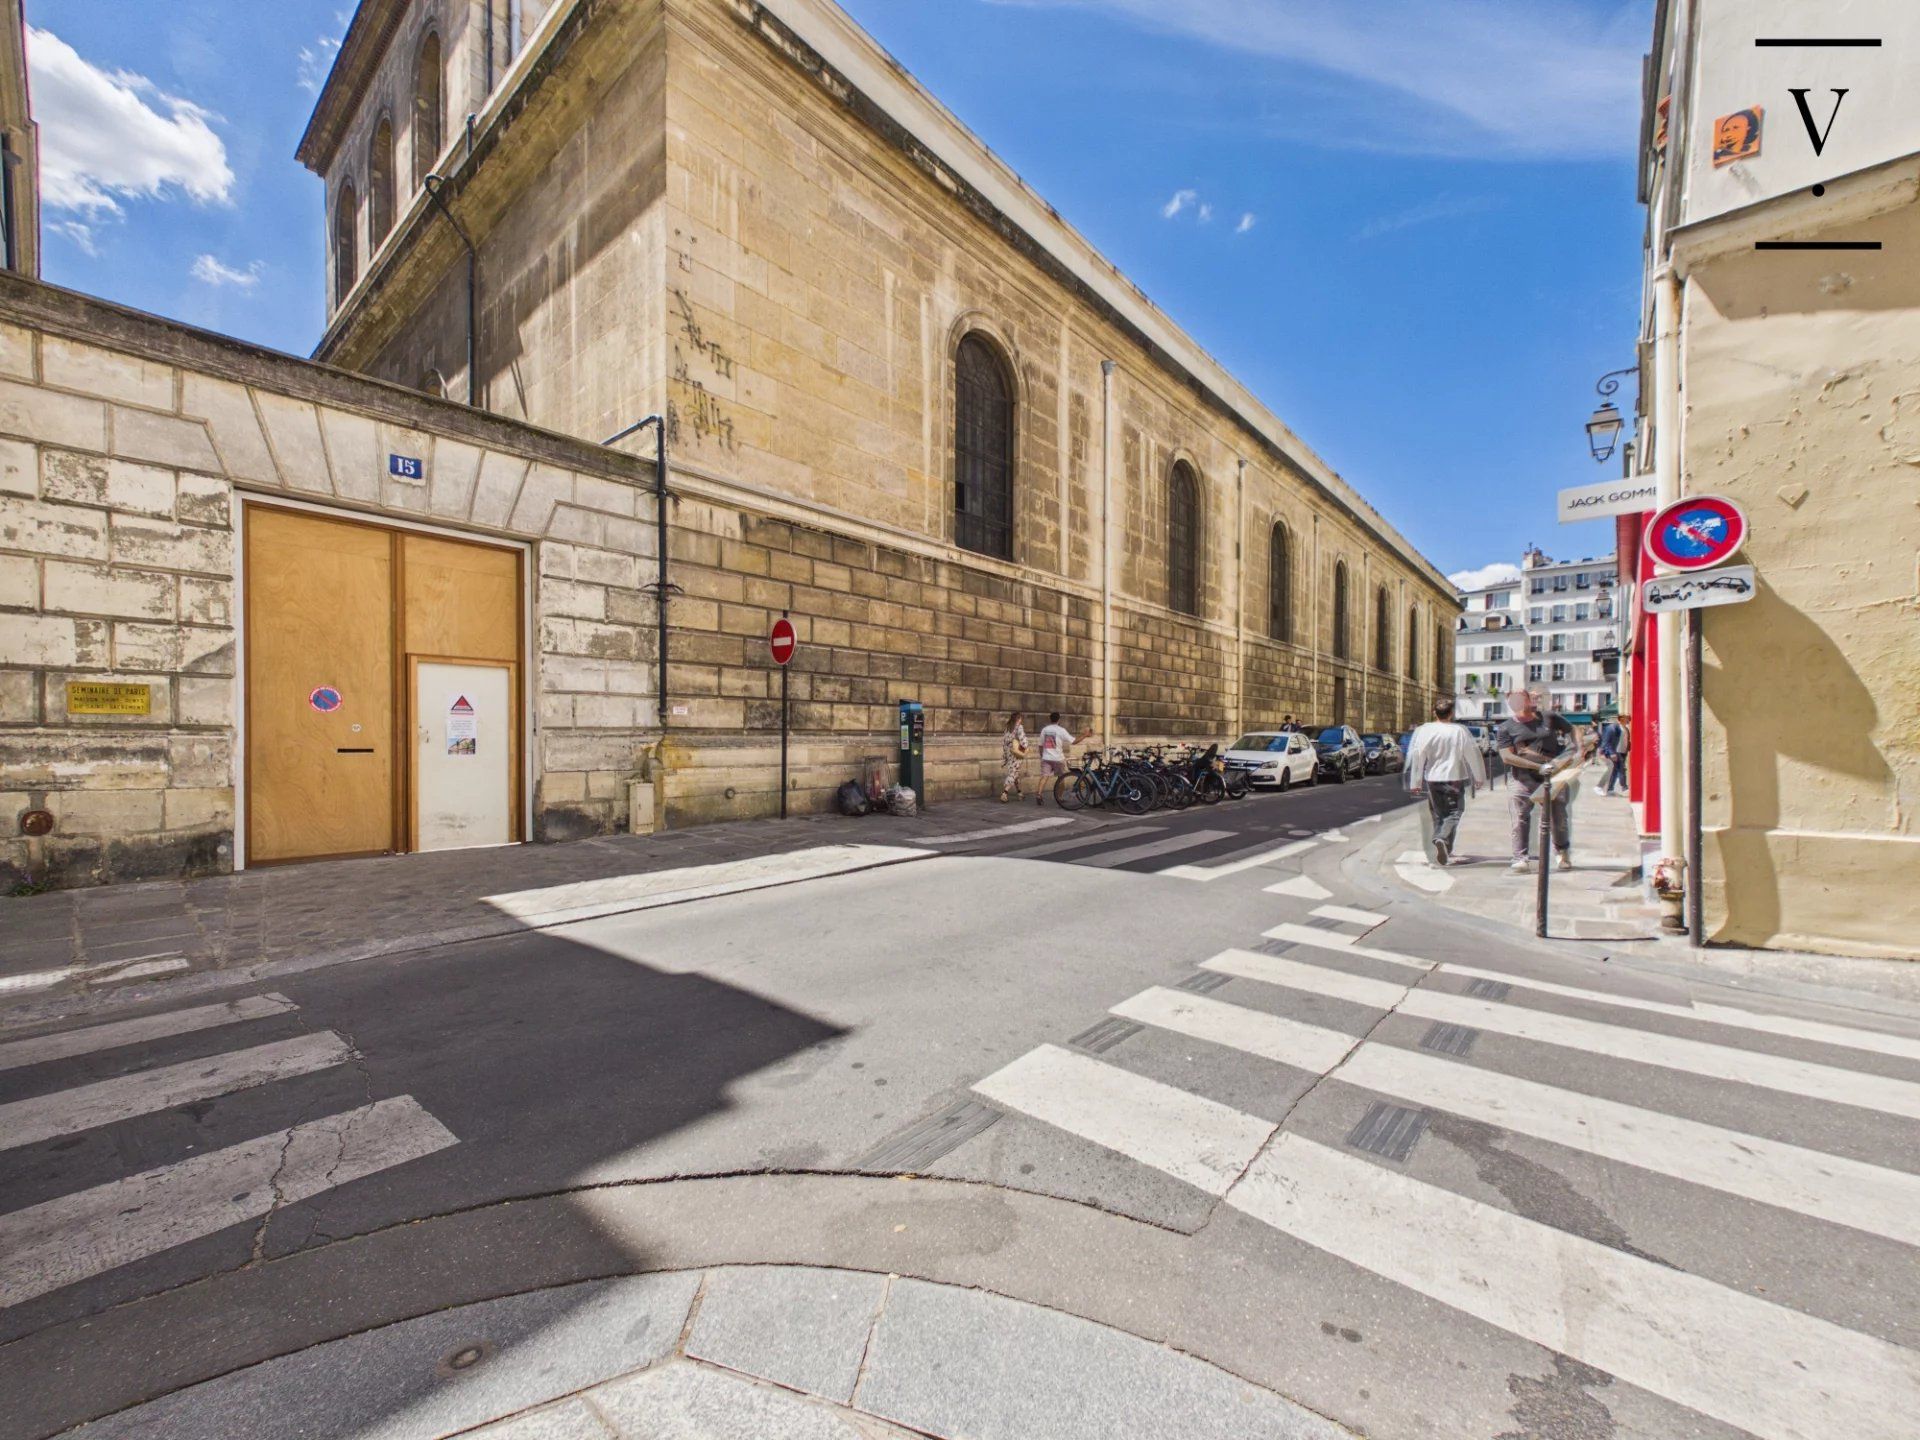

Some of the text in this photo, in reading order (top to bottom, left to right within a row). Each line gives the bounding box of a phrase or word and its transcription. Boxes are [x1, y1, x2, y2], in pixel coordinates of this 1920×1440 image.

[397, 458, 415, 475] 15
[1567, 494, 1605, 509] JACK
[114, 687, 121, 695] DE
[126, 687, 145, 695] PARIS
